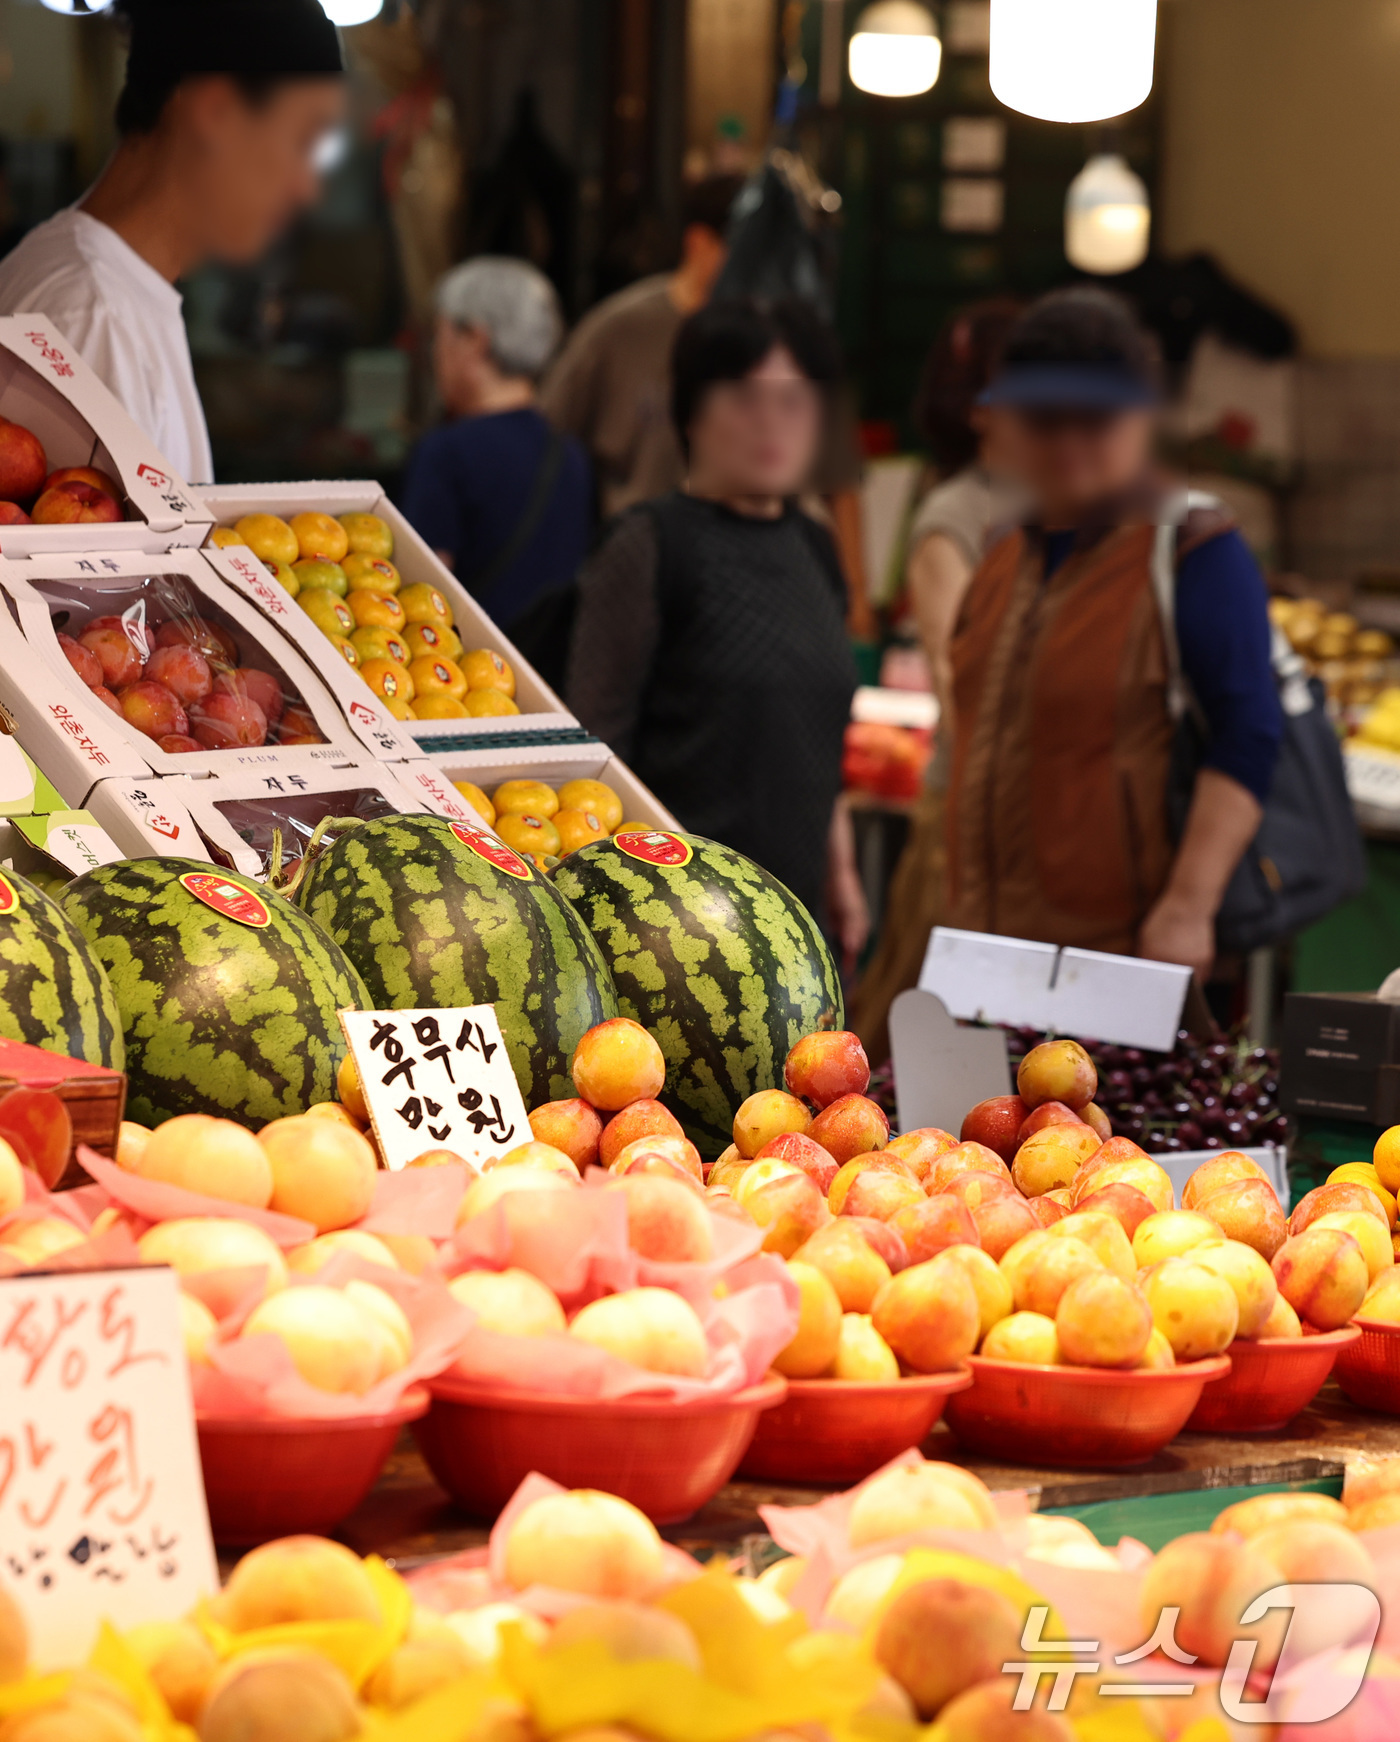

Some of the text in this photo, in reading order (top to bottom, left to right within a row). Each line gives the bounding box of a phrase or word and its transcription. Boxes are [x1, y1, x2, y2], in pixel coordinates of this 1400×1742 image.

[24, 331, 75, 378] 복숭아
[74, 559, 121, 574] 자두
[228, 557, 288, 614] 와촌자두
[48, 704, 111, 766] 와촌자두
[237, 754, 279, 763] PLUM
[261, 774, 309, 792] 자두
[415, 773, 471, 823] 촌자두
[369, 1015, 498, 1090] 후무사
[2, 1285, 172, 1389] 황도
